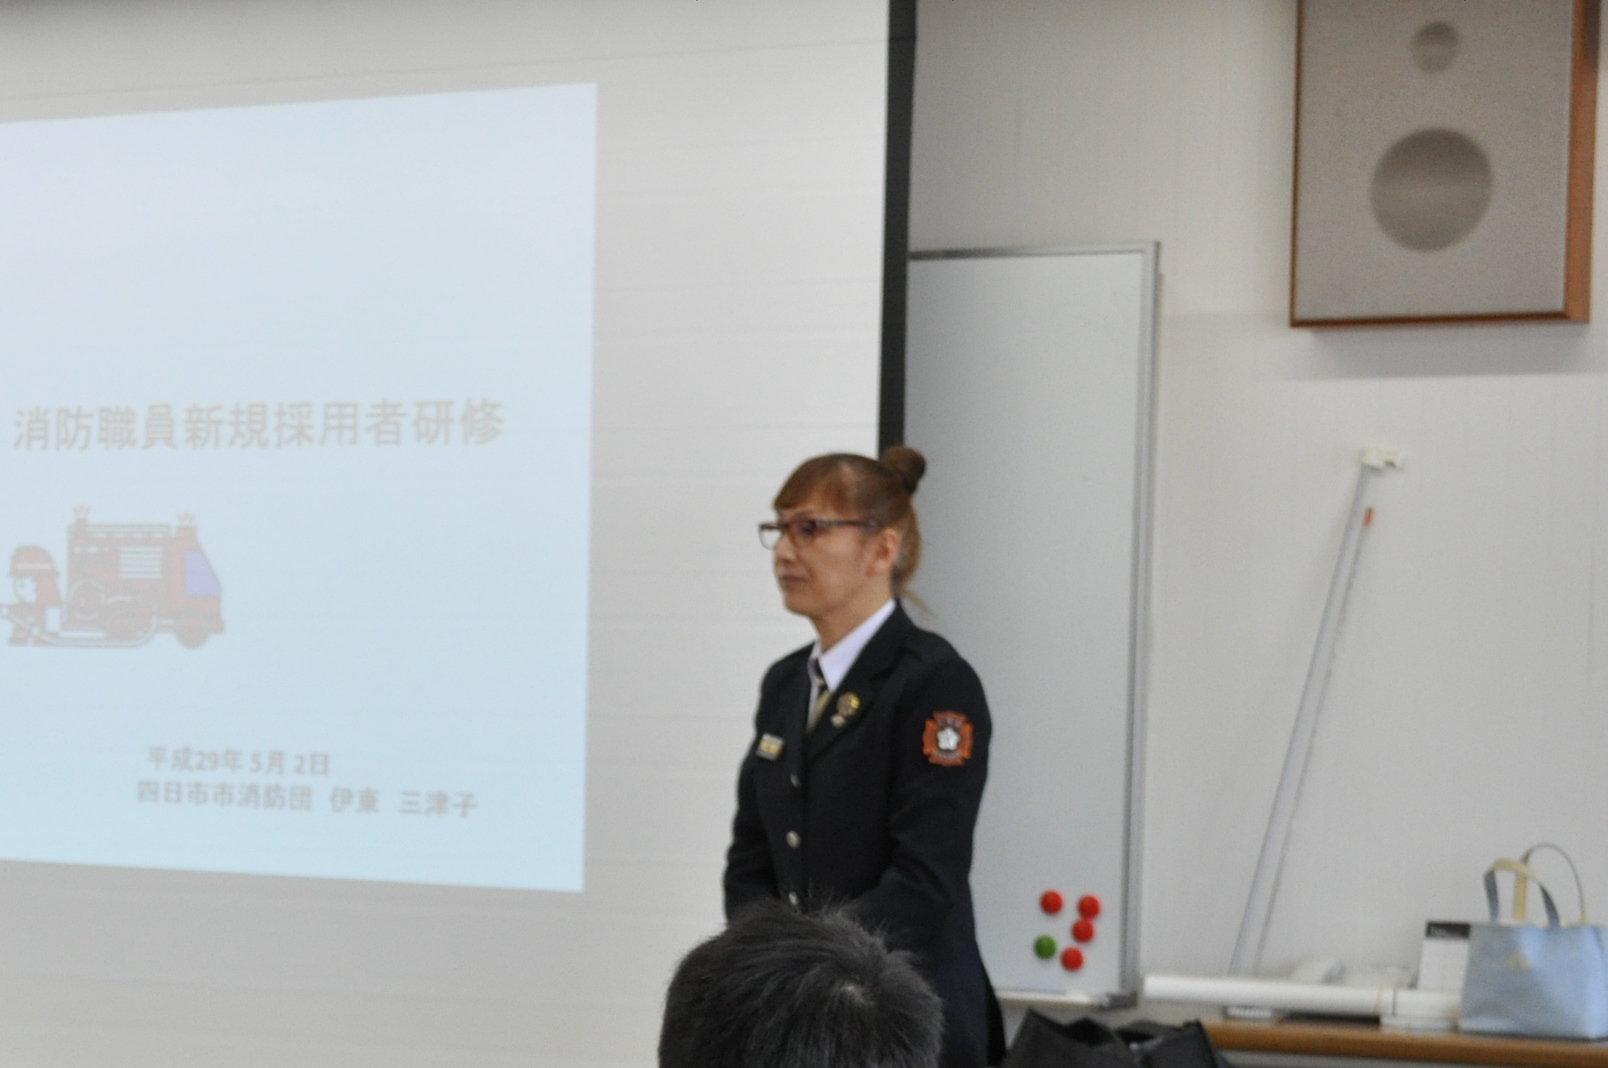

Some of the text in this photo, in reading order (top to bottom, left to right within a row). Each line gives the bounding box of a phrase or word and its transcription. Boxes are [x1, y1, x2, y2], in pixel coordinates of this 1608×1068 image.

[12, 398, 505, 453] 消防職員新規採用者研修
[146, 746, 244, 772] 平成29年
[137, 779, 314, 812] 四日市市消防団
